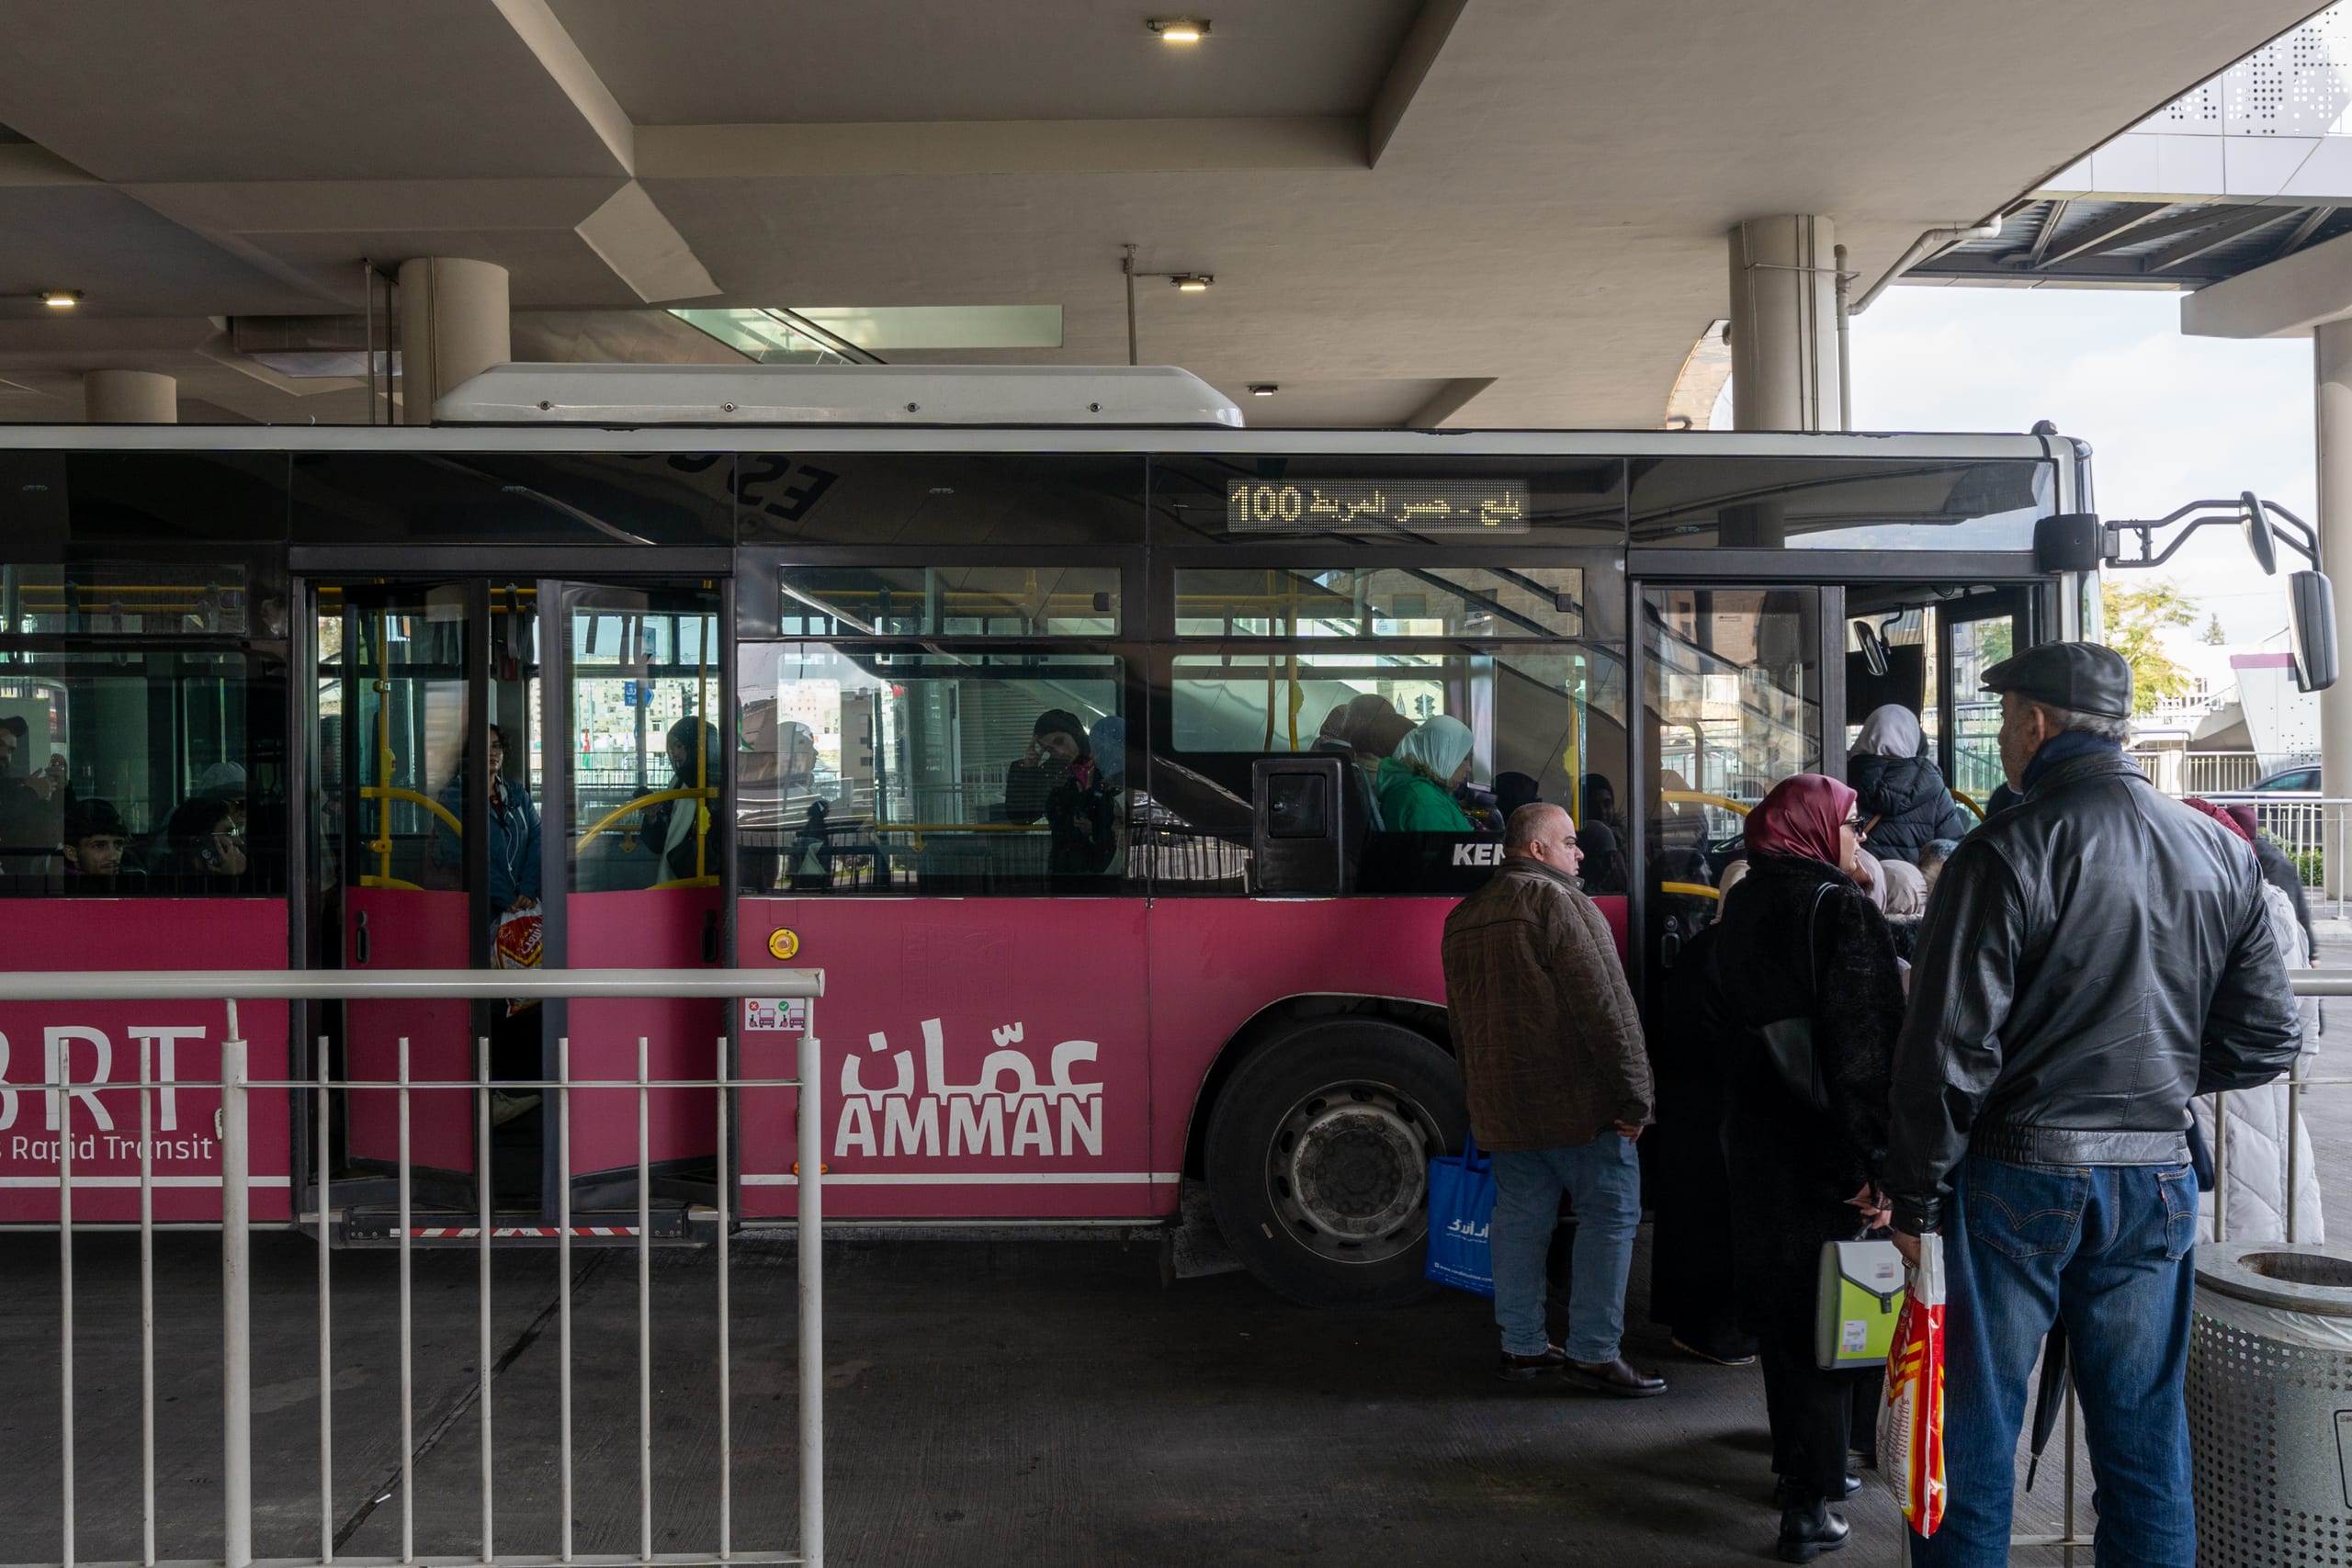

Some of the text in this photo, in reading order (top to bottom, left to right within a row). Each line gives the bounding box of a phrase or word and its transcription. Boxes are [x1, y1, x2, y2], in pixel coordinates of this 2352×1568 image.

[1231, 485, 1301, 521] 100
[834, 1097, 1102, 1156] AMMAN
[12, 1134, 95, 1164] Rapid
[103, 1133, 213, 1160] Transit
